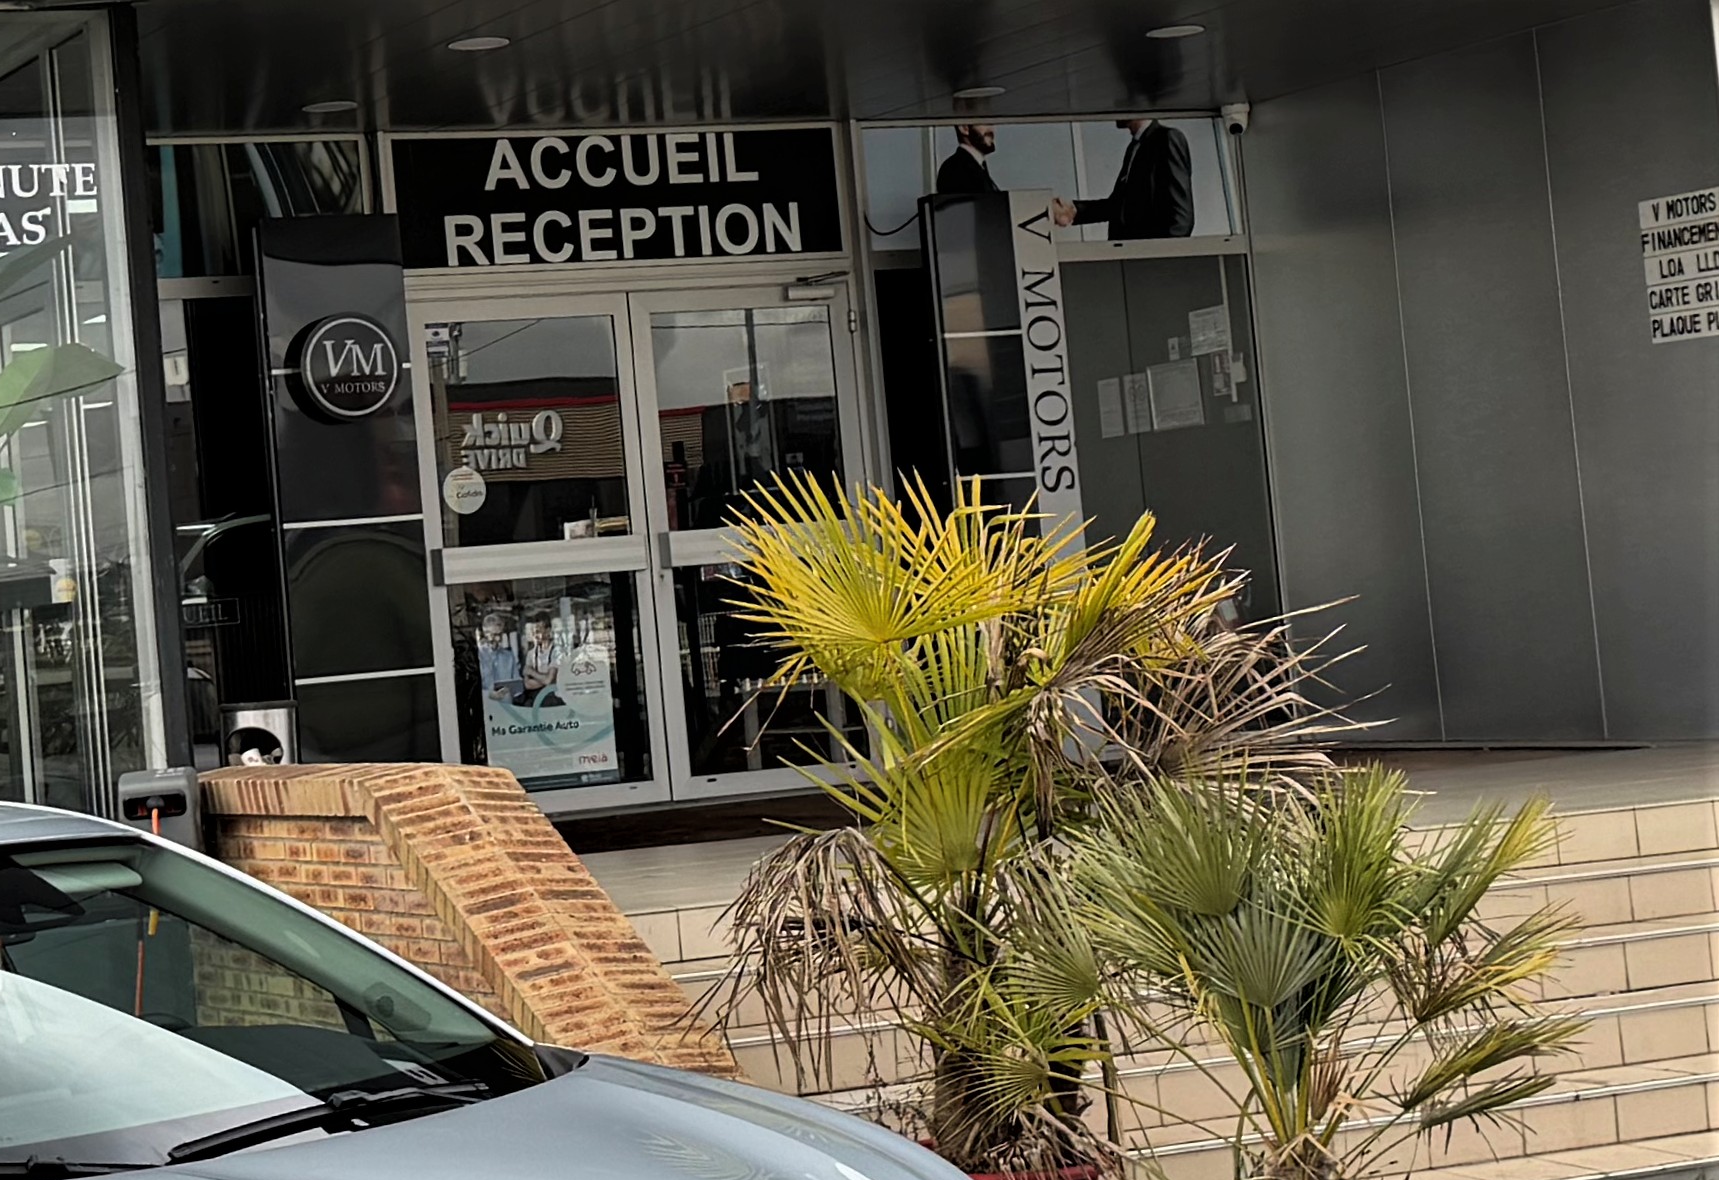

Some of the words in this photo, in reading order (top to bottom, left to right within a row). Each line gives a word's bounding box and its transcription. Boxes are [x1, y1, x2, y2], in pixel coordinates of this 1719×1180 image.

[484, 133, 759, 191] ACCUEIL
[1651, 202, 1660, 222] V
[1666, 192, 1717, 220] MOTORS
[443, 202, 803, 268] RECEPTION
[1017, 210, 1052, 245] V
[1659, 256, 1686, 279] LOA
[1649, 286, 1691, 310] CARTE
[322, 339, 388, 378] VM
[334, 381, 386, 394] MOTORS
[1022, 267, 1076, 494] MOTORS
